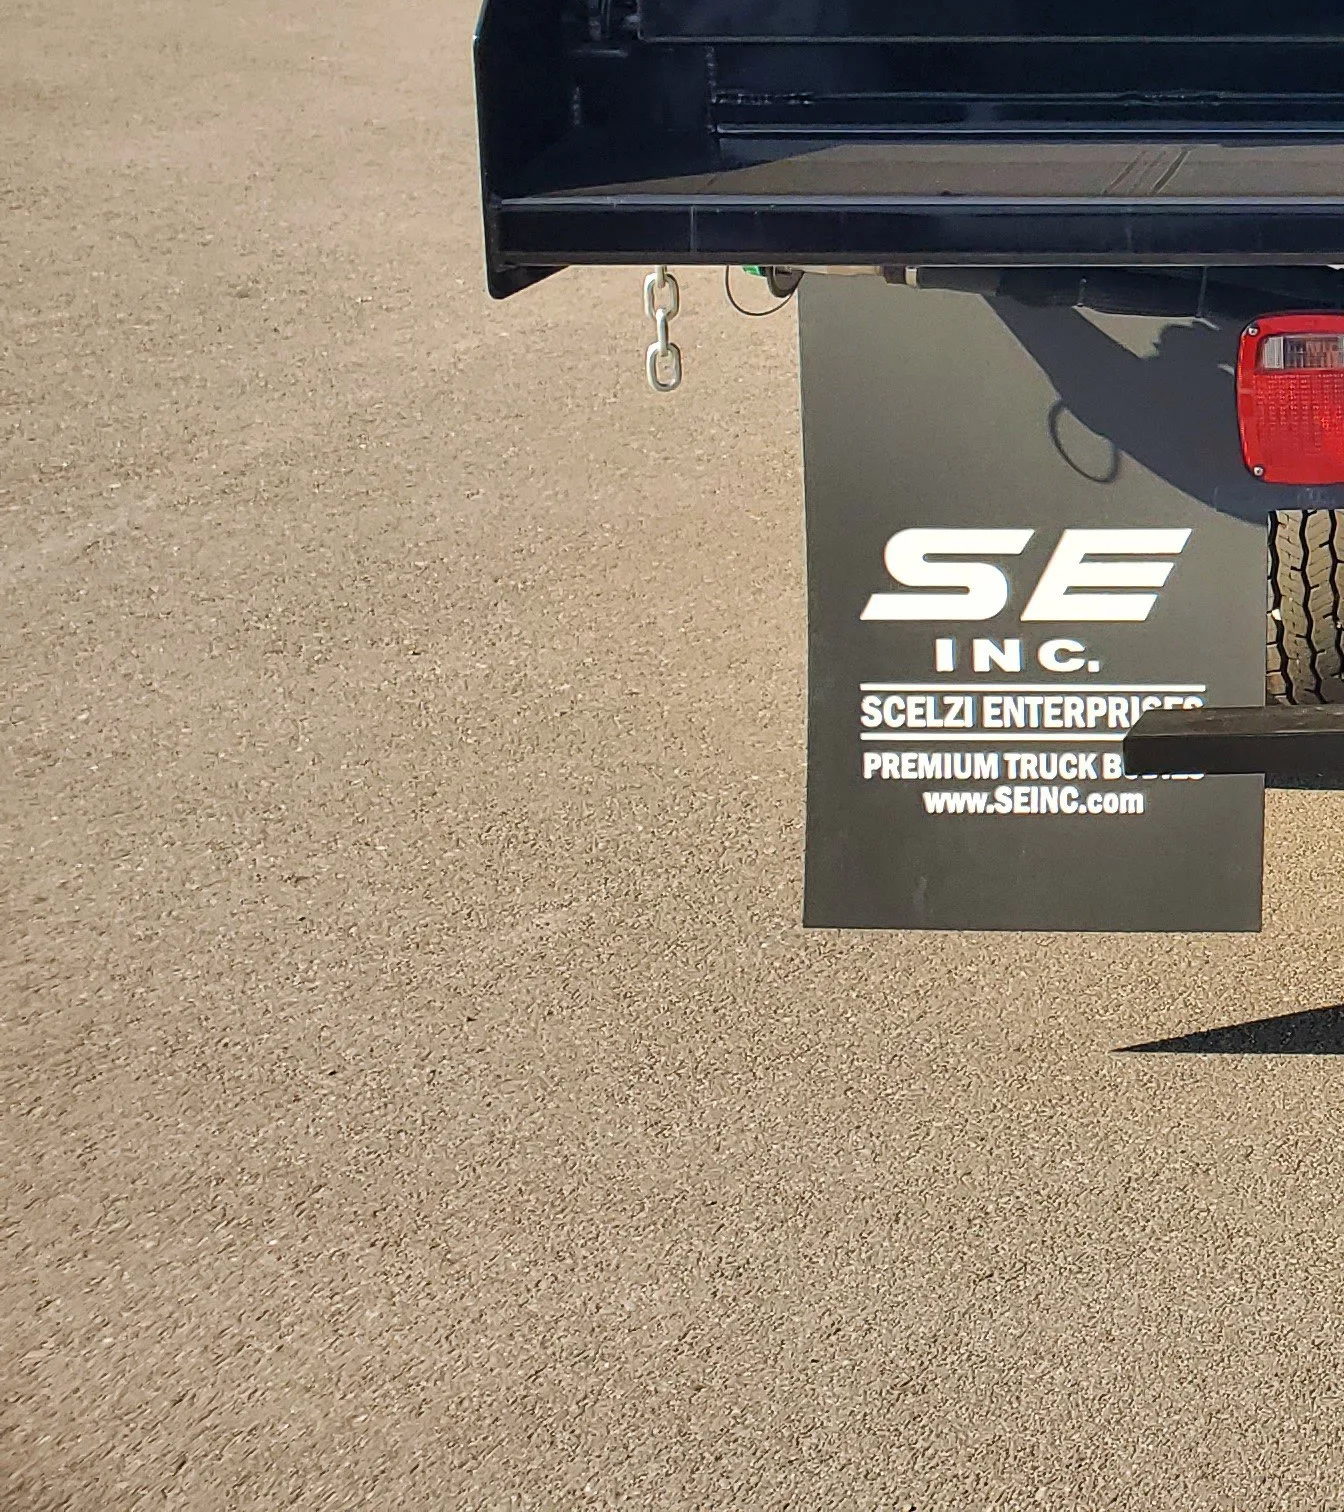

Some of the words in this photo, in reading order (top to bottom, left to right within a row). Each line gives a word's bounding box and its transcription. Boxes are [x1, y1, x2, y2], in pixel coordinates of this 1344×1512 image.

[860, 528, 1192, 622] SE
[935, 638, 1101, 673] INC.
[861, 696, 973, 728] SCELZI
[863, 752, 999, 780] PREMIUM
[1003, 752, 1098, 780] TRUCK
[922, 786, 1145, 815] www.SEINC.com
